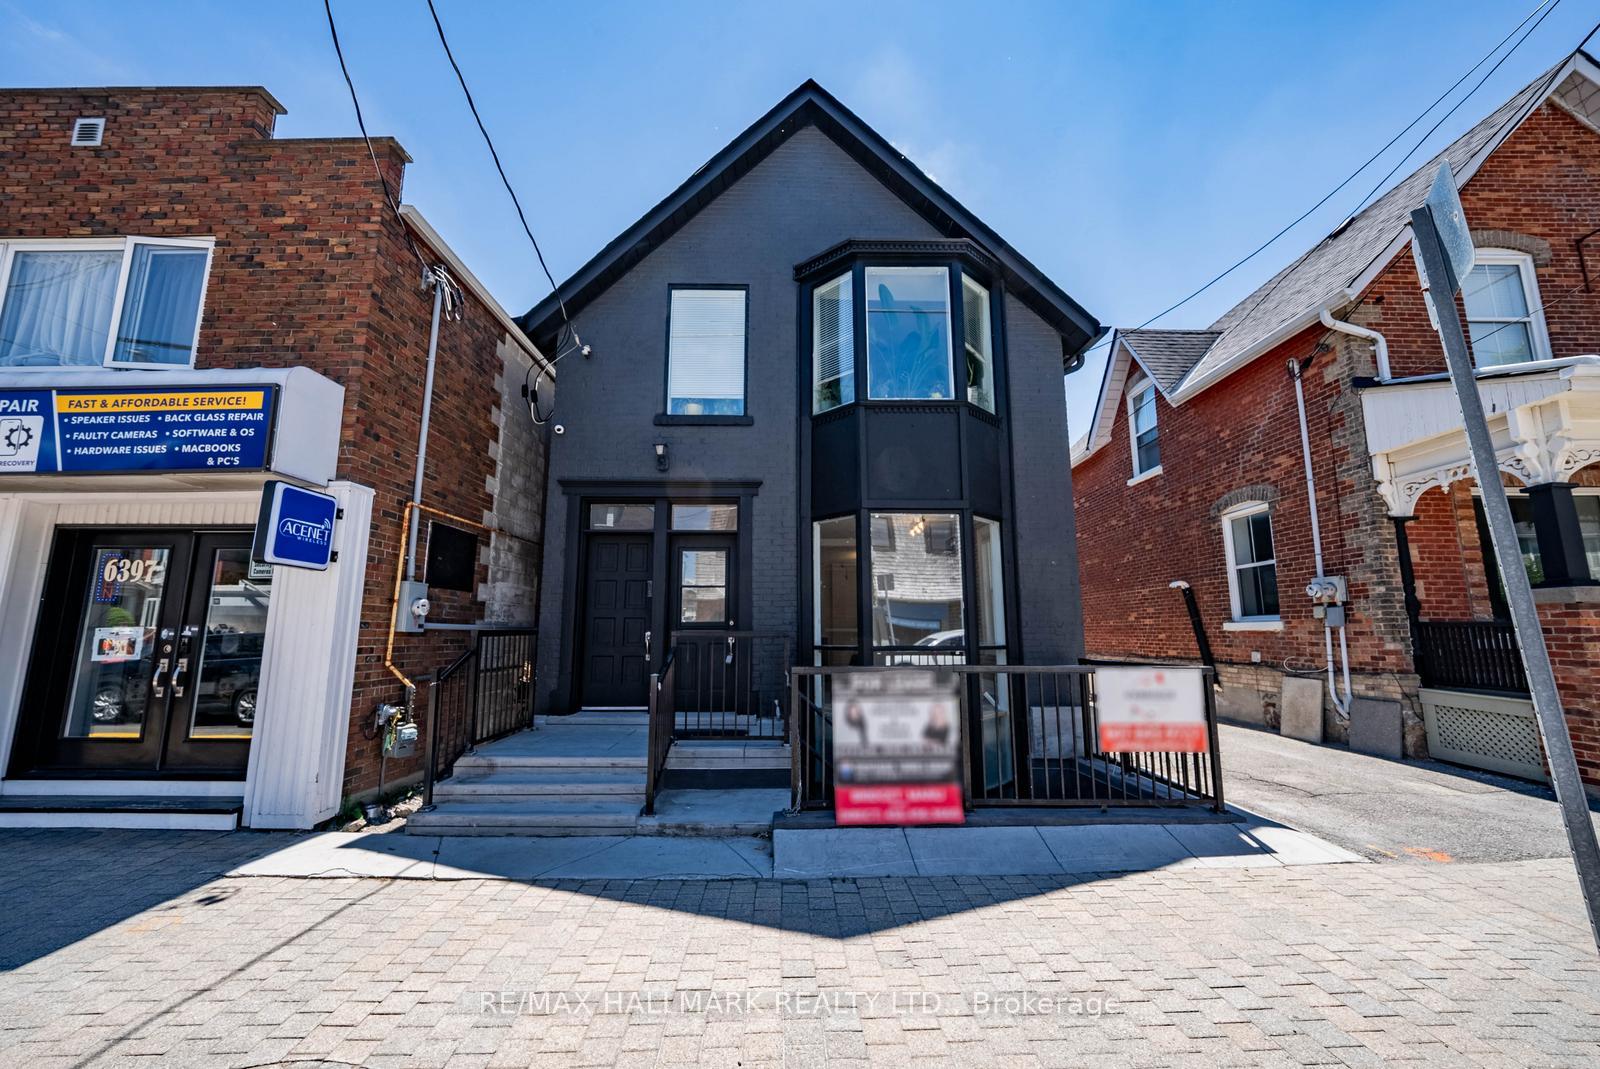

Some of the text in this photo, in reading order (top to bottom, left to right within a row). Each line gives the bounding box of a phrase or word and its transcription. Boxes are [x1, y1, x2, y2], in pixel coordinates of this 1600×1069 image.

[68, 396, 247, 409] FAST & AFFORDABLE SERVICE!
[71, 414, 151, 424] SPEAKER ISSUES
[164, 412, 264, 422] BACK GLASS REPAIR
[72, 430, 158, 440] FAULTY CAMERAS
[172, 428, 255, 437] SOFTWARE & OS
[73, 445, 167, 455] HARDWARE ISSUES
[181, 443, 241, 453] MACBOOKS
[206, 456, 240, 466] & PC'S
[282, 521, 331, 542] ACENET
[297, 536, 328, 546] WIRELESS
[103, 558, 158, 583] 6397
